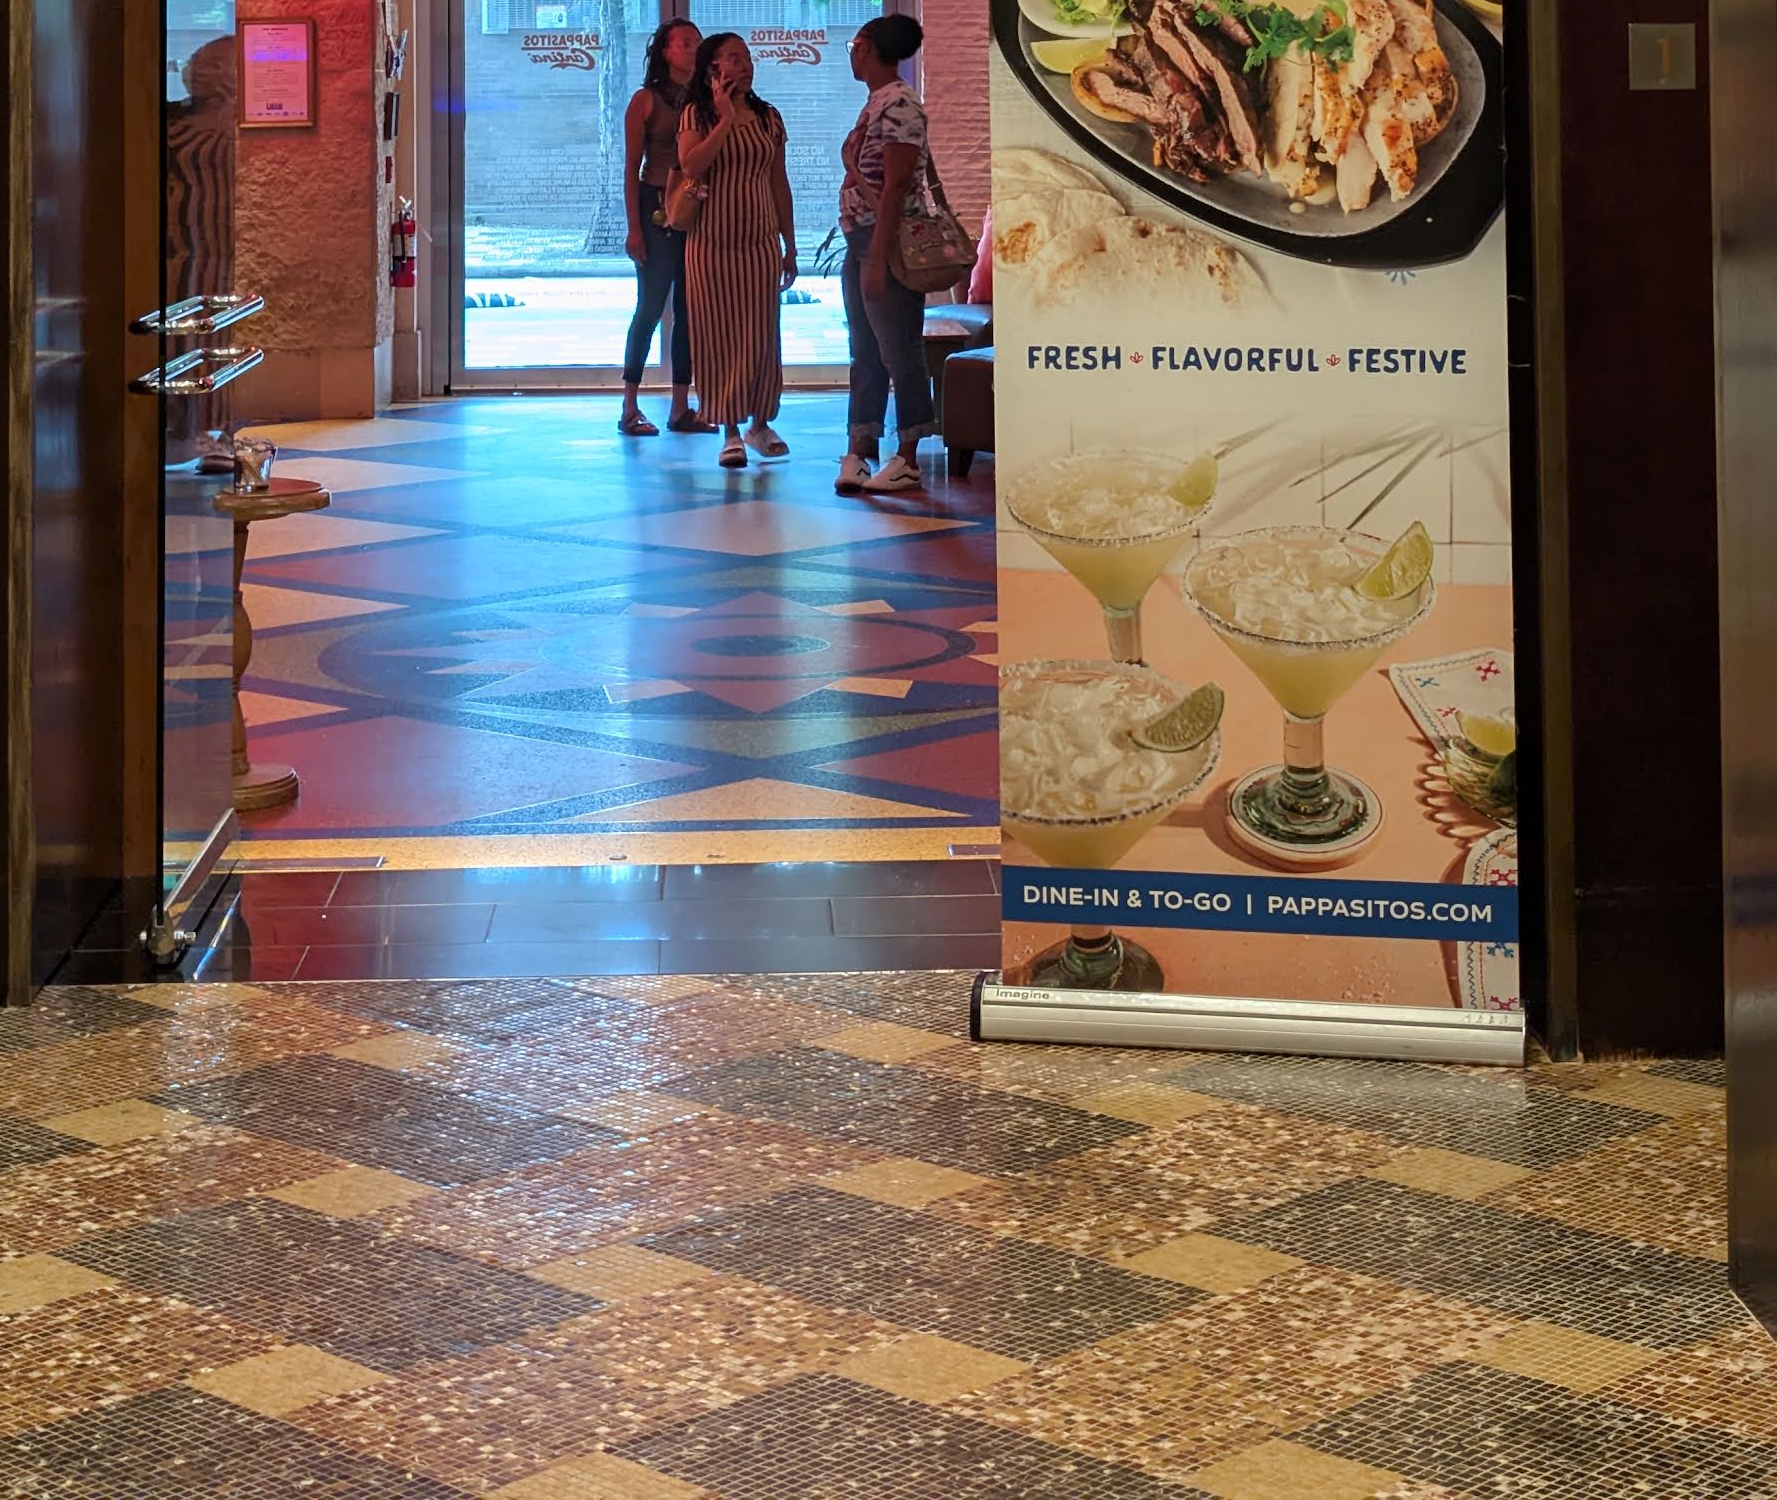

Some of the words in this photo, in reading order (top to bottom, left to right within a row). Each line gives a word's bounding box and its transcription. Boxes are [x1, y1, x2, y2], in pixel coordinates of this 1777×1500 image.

[1656, 36, 1670, 76] 1
[1027, 345, 1122, 370] FRESH
[1152, 346, 1320, 372] FLAVORFUL
[1348, 348, 1467, 374] FESTIVE
[1023, 885, 1119, 907] DINE-IN
[1127, 890, 1142, 908] &
[1149, 890, 1231, 912] TO-GO
[1267, 895, 1492, 923] PAPPASITOS.COM
[996, 988, 1050, 1000] Imagine
